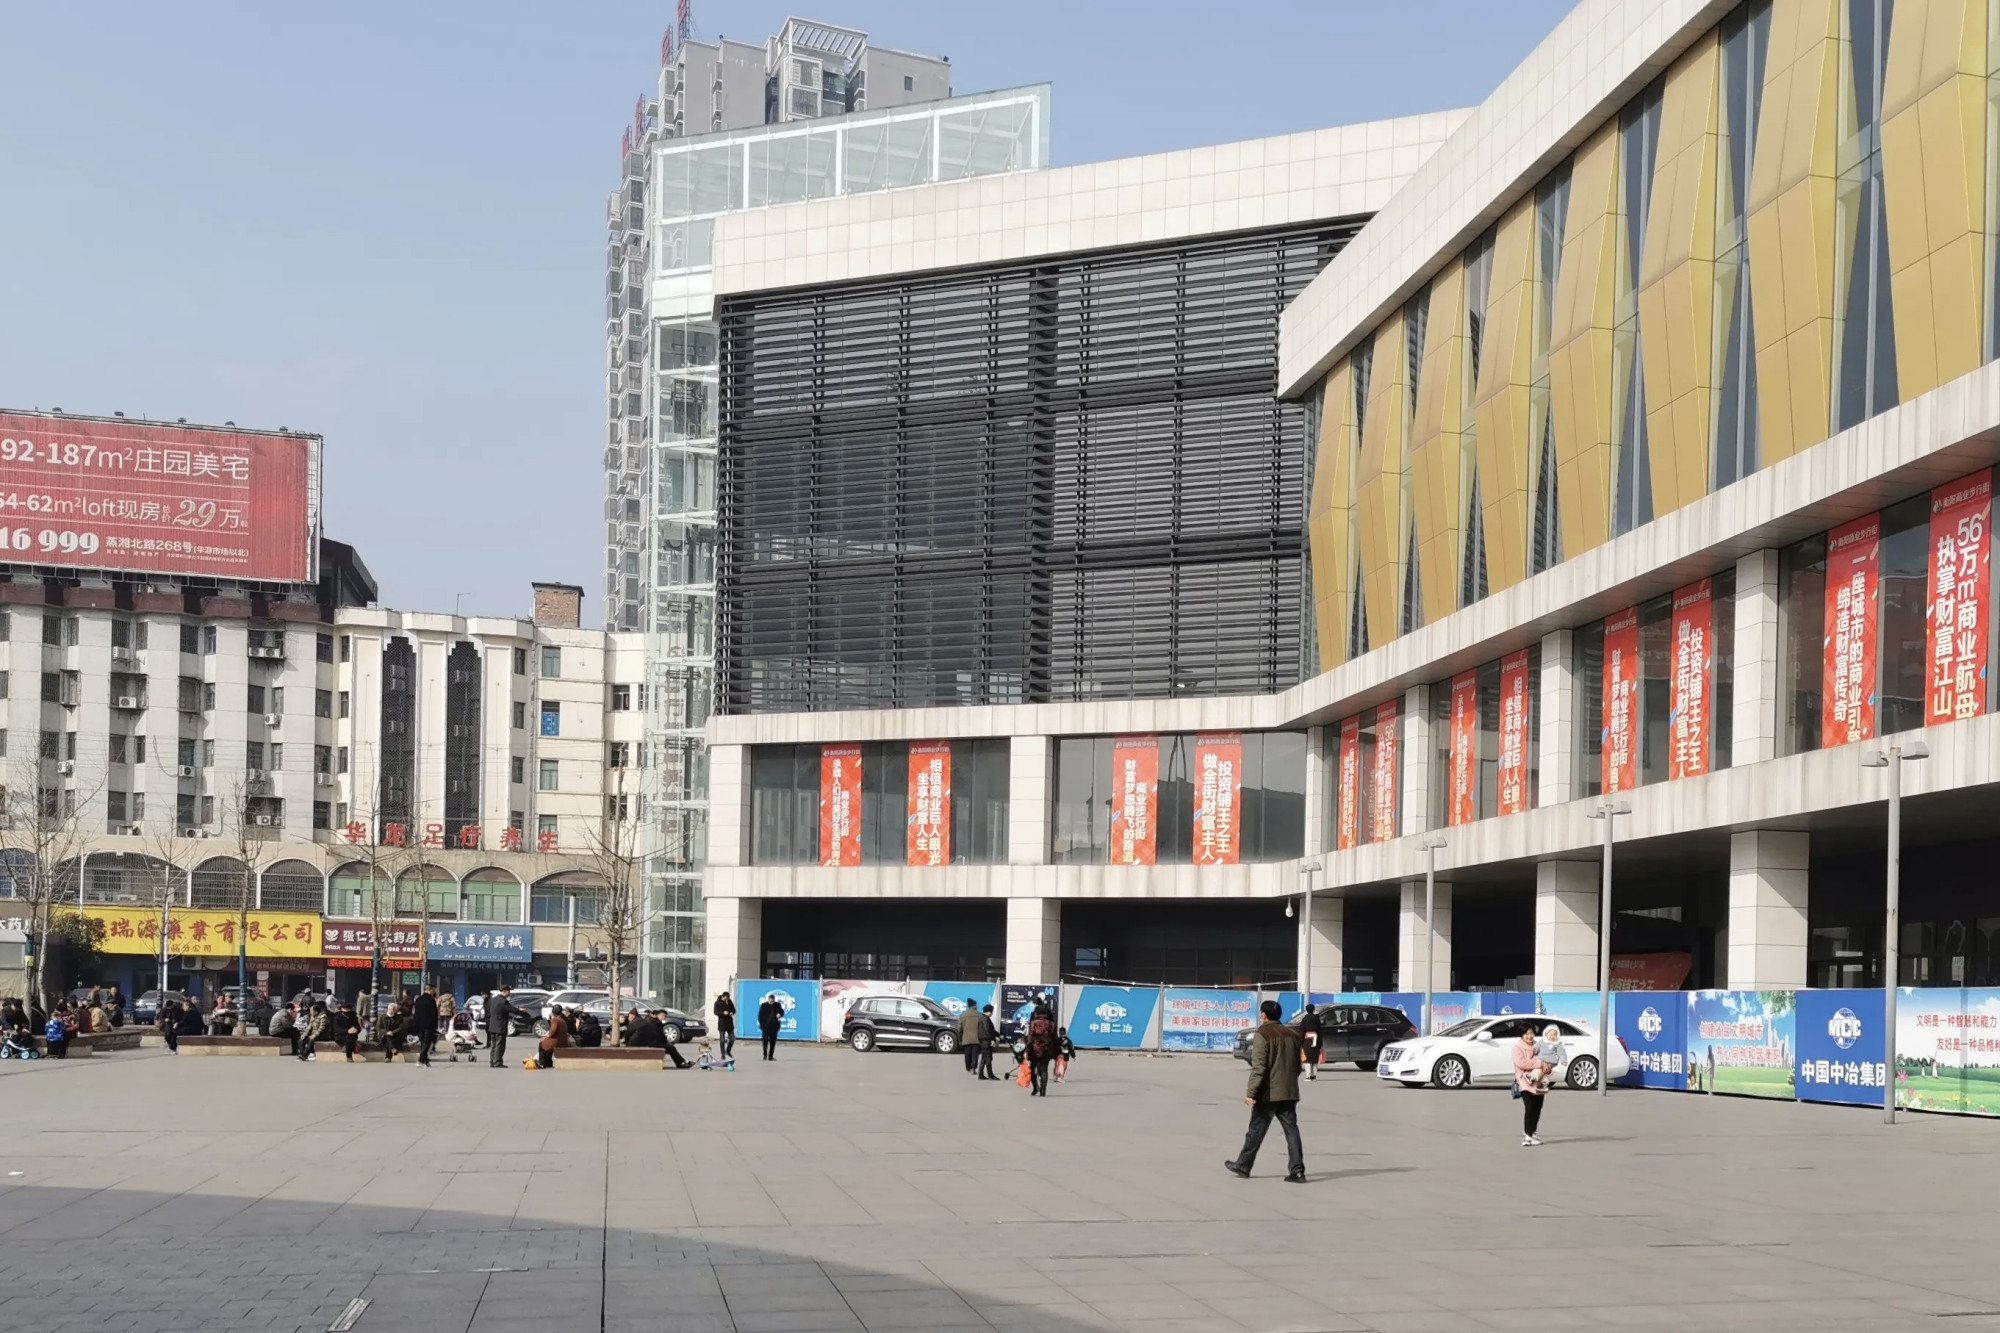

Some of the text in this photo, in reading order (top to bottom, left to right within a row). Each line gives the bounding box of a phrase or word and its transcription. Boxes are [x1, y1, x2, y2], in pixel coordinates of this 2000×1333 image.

[1943, 483, 1990, 508] 衡阳商业步行街
[38, 529, 99, 555] 999
[1837, 524, 1878, 547] 衡阳商业步行街
[1932, 536, 1956, 716] 执掌财富江山
[1833, 587, 1851, 722] 缔造财富传奇
[1619, 680, 1629, 766] 商业步行街
[1675, 619, 1691, 779] 做金街财富主人
[1687, 627, 1704, 771] 投资铺王之王
[1503, 697, 1513, 804] 坐享财富人生
[841, 790, 850, 837] 商业步行街
[916, 772, 929, 851] 坐享财富人生
[928, 758, 943, 864] 相信商业巨人眼光
[1135, 782, 1147, 840] 商业步行街
[1201, 753, 1218, 861] 做金街财富主人
[1216, 761, 1233, 853] 投资铺王之王
[1089, 1022, 1133, 1034] 中国二冶
[1095, 1006, 1127, 1017] MCC
[1172, 1015, 1250, 1028] 美丽家园你我共建
[1638, 1016, 1662, 1032] MCC
[1828, 1018, 1862, 1038] MCC
[1916, 1014, 1998, 1029] 文明是一种智慧和能力
[1801, 1059, 1886, 1087] 中国中冶集团
